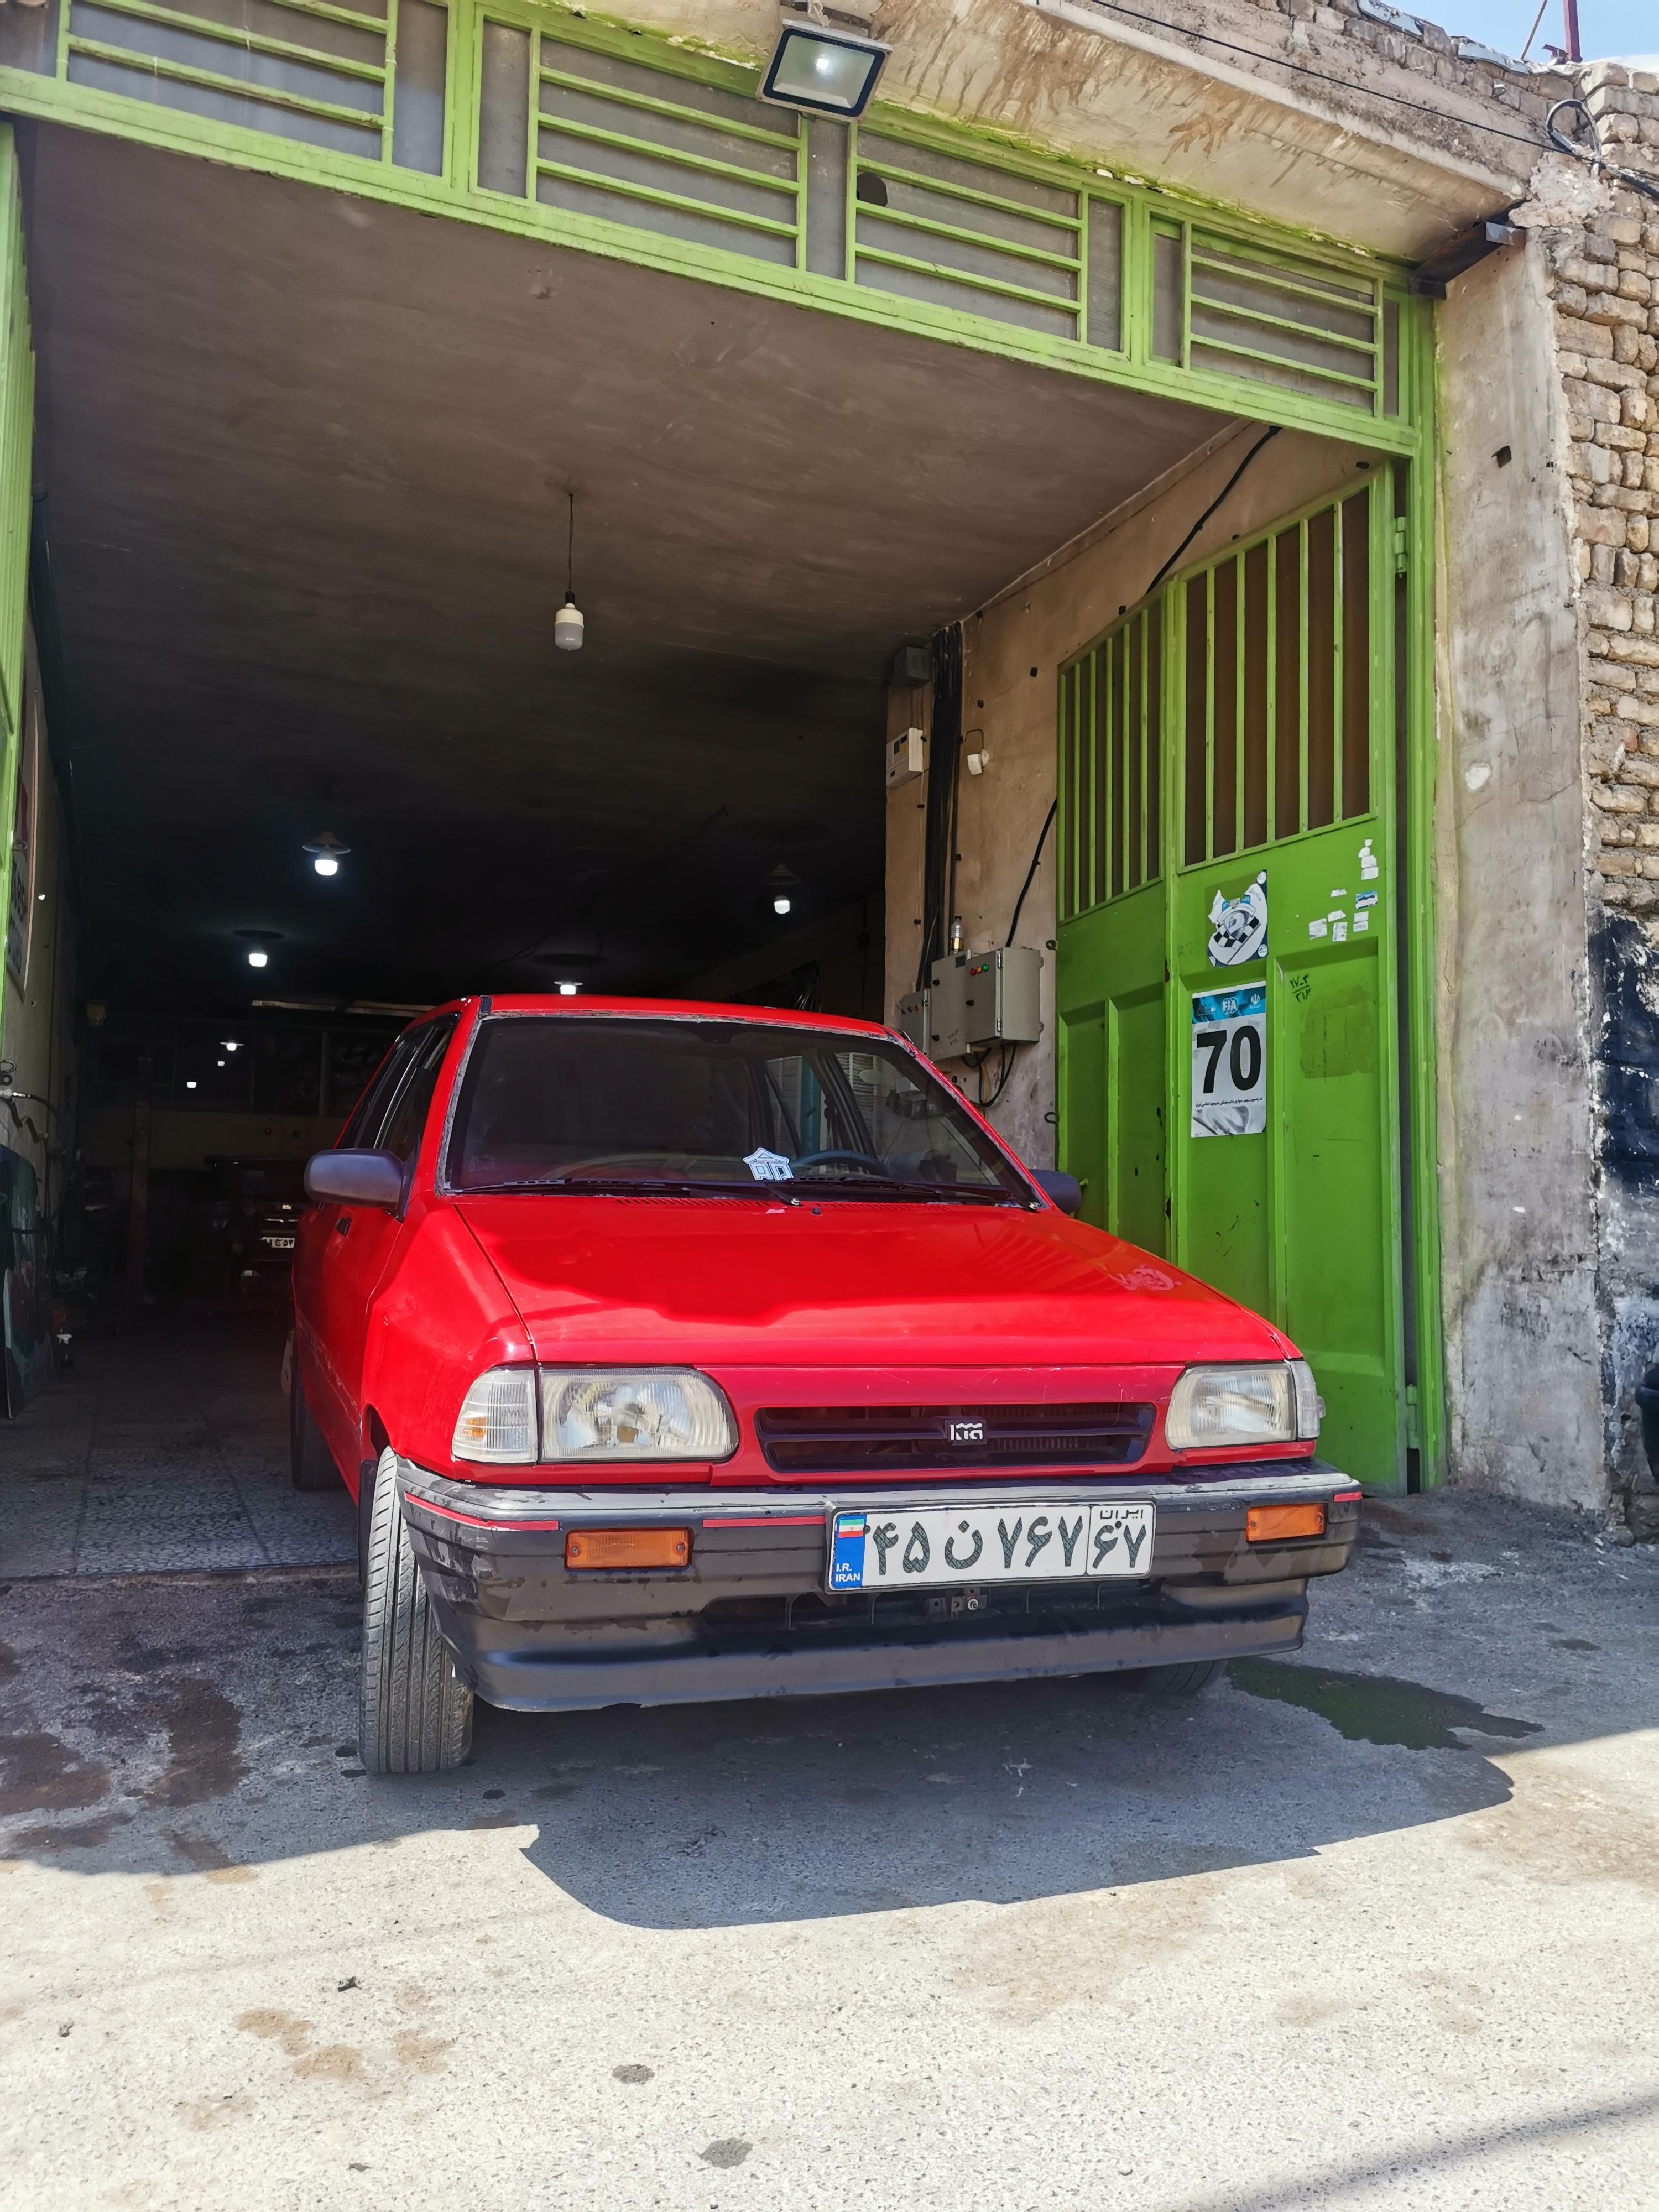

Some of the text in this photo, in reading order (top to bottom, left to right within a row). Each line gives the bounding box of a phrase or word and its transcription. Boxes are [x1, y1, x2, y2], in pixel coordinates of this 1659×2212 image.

[1222, 999, 1237, 1012] FIA
[1196, 1025, 1261, 1094] 70
[1100, 1509, 1144, 1520] ایران
[836, 1563, 853, 1572] I.R.
[836, 1572, 861, 1583] IRAN
